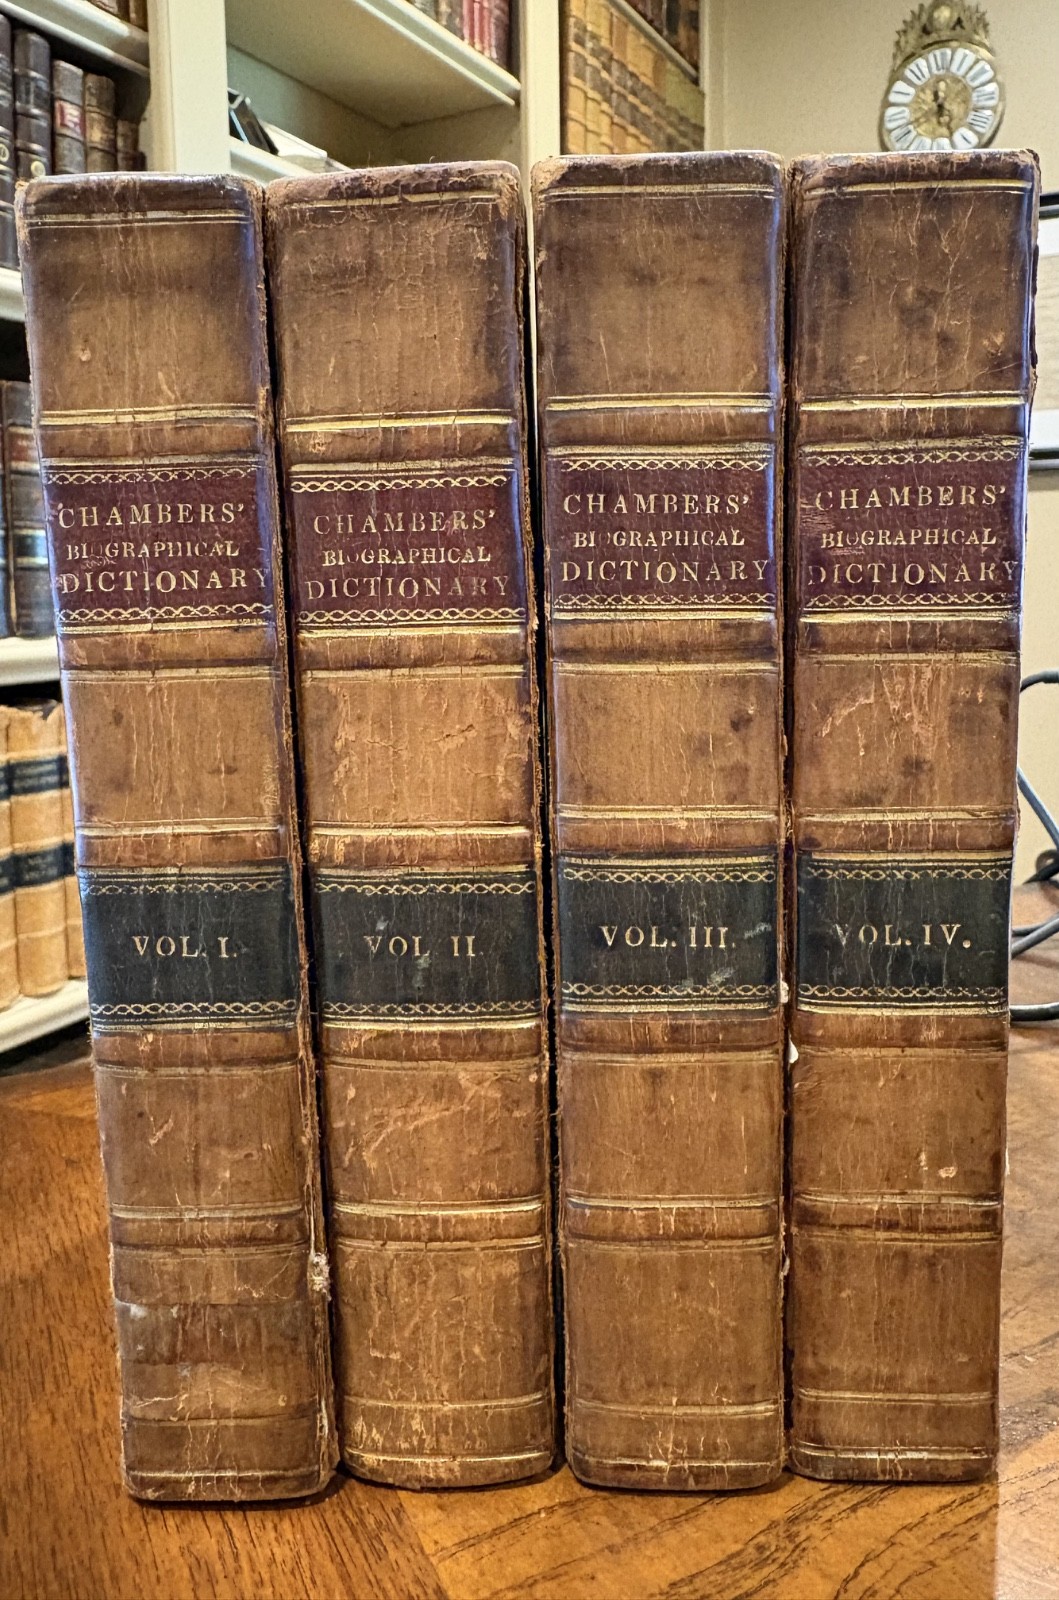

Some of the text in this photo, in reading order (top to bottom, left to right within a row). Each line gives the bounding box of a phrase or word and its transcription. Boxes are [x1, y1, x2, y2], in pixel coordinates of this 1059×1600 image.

[563, 493, 749, 515] CHAMBERS'
[814, 484, 1006, 511] CHAMBERS'
[313, 509, 497, 535] CHAMBERS'
[573, 529, 745, 548] BIGRAPHICAL
[59, 567, 270, 594] DICTIONARY
[561, 559, 770, 584] DICTIONARY
[807, 560, 1019, 586] DICTIONARY
[304, 575, 510, 600] DICTIONARY
[217, 936, 237, 958] I.
[598, 925, 736, 948] VOL. III.
[832, 923, 972, 948] VOL. IV.
